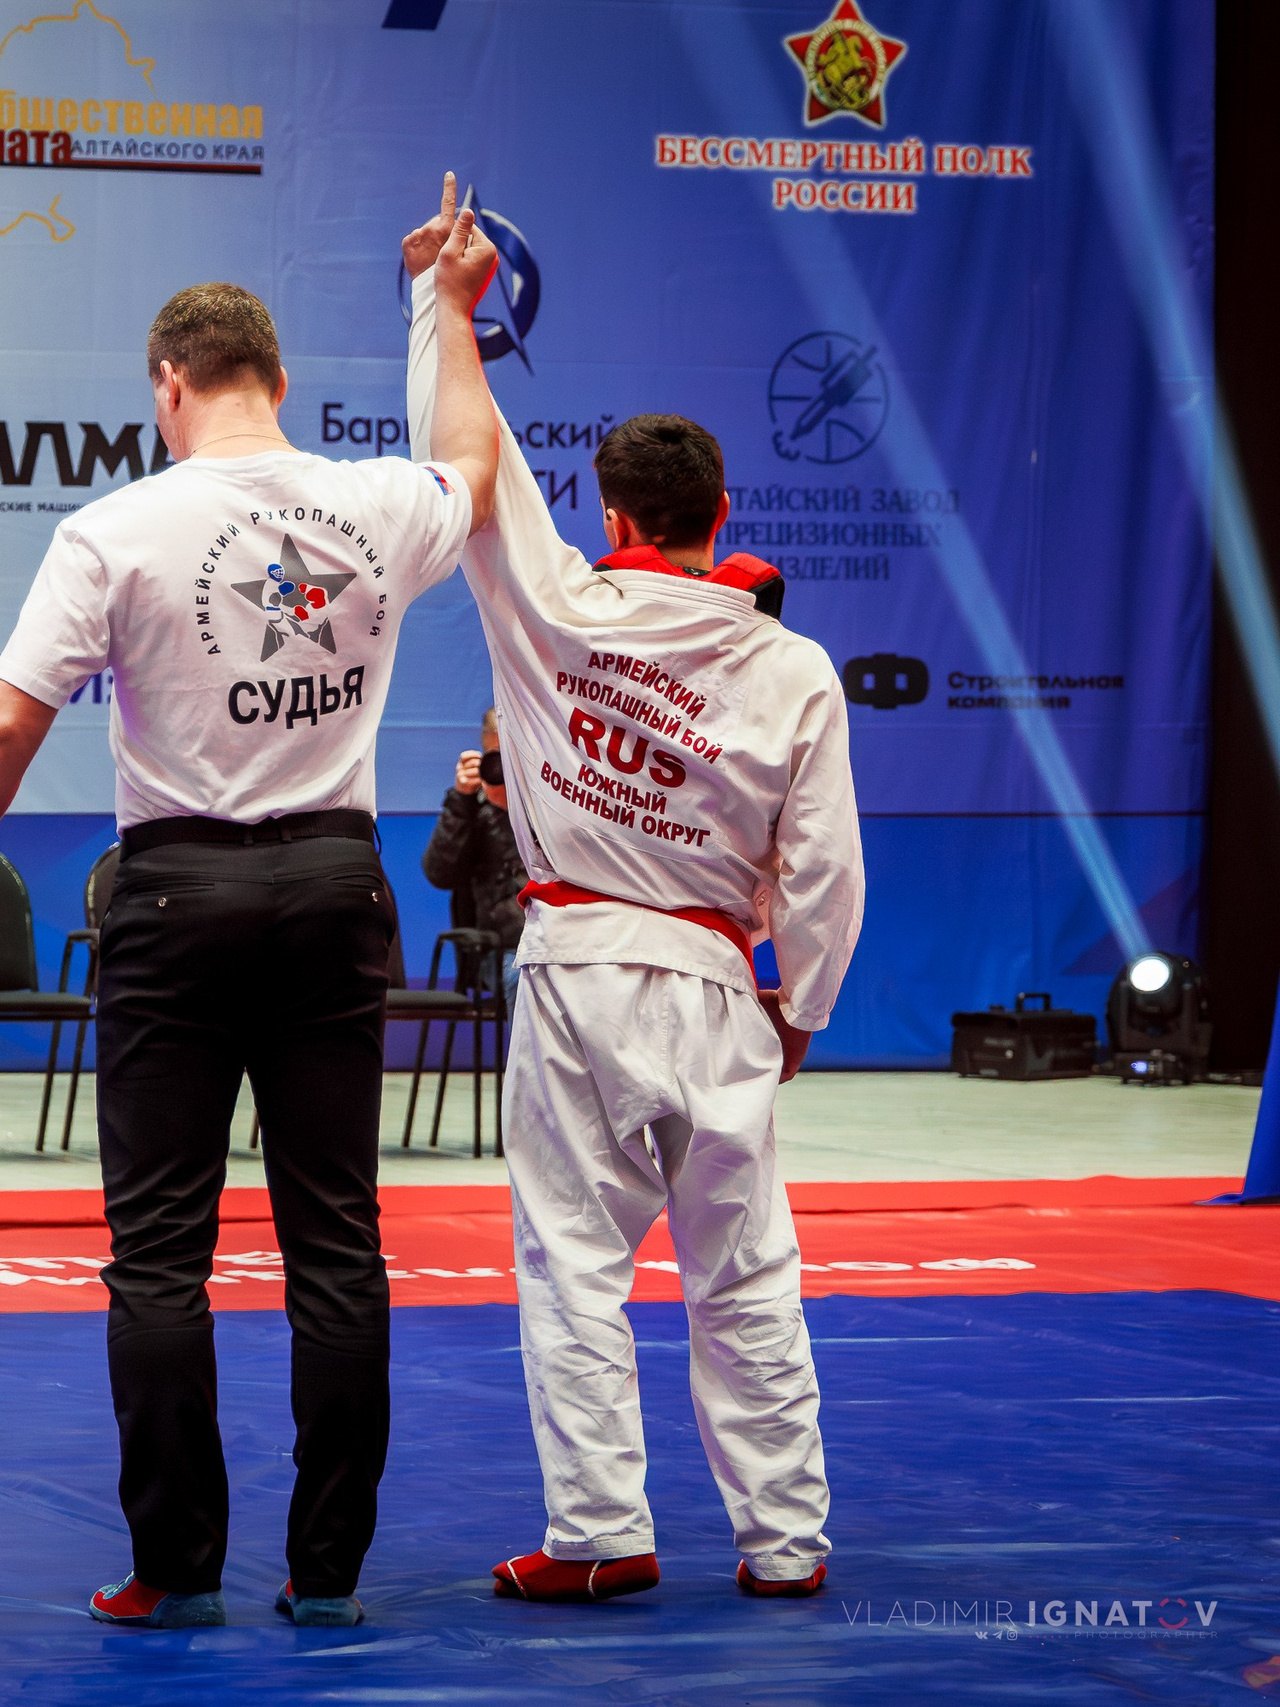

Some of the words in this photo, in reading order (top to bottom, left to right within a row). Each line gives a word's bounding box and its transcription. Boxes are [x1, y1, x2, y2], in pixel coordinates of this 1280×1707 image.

[71, 138, 207, 159] АЛТАЙСКОГО
[213, 143, 265, 161] КРАЯ
[657, 135, 924, 173] БЕССМЕРТНЫЙ
[933, 145, 1033, 175] ПОЛК
[773, 179, 917, 212] РОССИИ
[872, 488, 961, 514] ЗАВОД
[194, 523, 241, 655] АРМЕЙСКИЙ
[250, 507, 385, 579] РУКОПАШНЫЙ
[370, 594, 387, 637] БОЙ
[228, 665, 365, 729] СУДЬЯ
[556, 671, 682, 740] РУКОПАШНЫЙ
[680, 728, 724, 765] БОЙ
[588, 651, 707, 721] АРМЕЙСКИЙ
[568, 706, 687, 788] RUS
[540, 761, 636, 829] ВОЕННЫЙ
[641, 814, 711, 847] ОКРУГ
[577, 763, 667, 815] ЮЖНЫЙ
